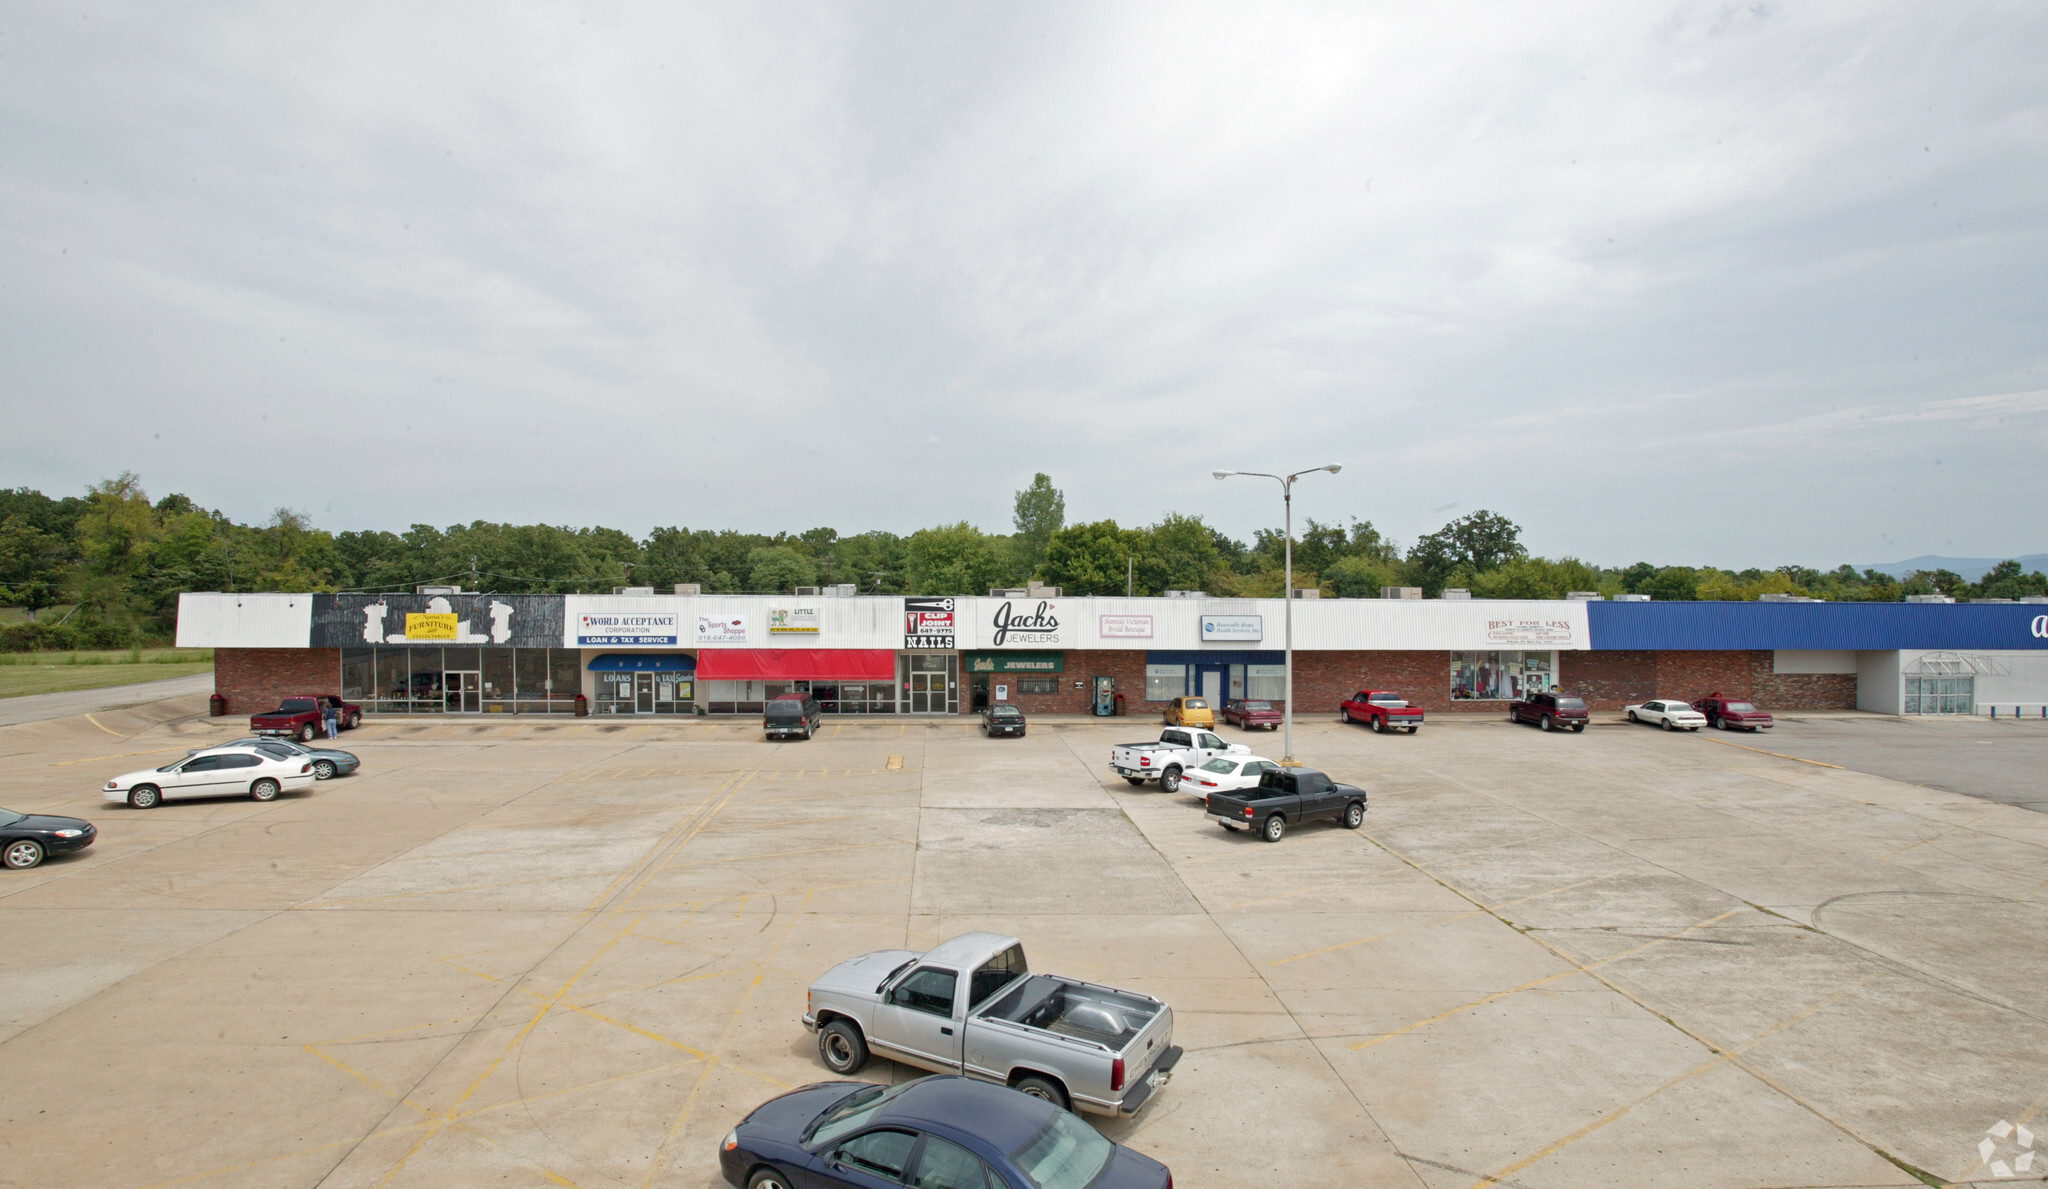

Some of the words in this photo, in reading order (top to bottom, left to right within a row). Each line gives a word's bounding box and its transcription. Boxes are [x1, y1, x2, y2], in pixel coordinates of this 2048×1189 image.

[590, 617, 619, 626] WORLD
[621, 617, 674, 626] ACCEPTANCE
[707, 621, 727, 629] Sports
[1488, 621, 1513, 629] BEST
[1546, 621, 1570, 630] LESS
[409, 621, 454, 632] FURNITURE
[906, 636, 953, 649] NAILS
[1006, 634, 1060, 643] JEWELERS
[604, 674, 631, 682] LOANS
